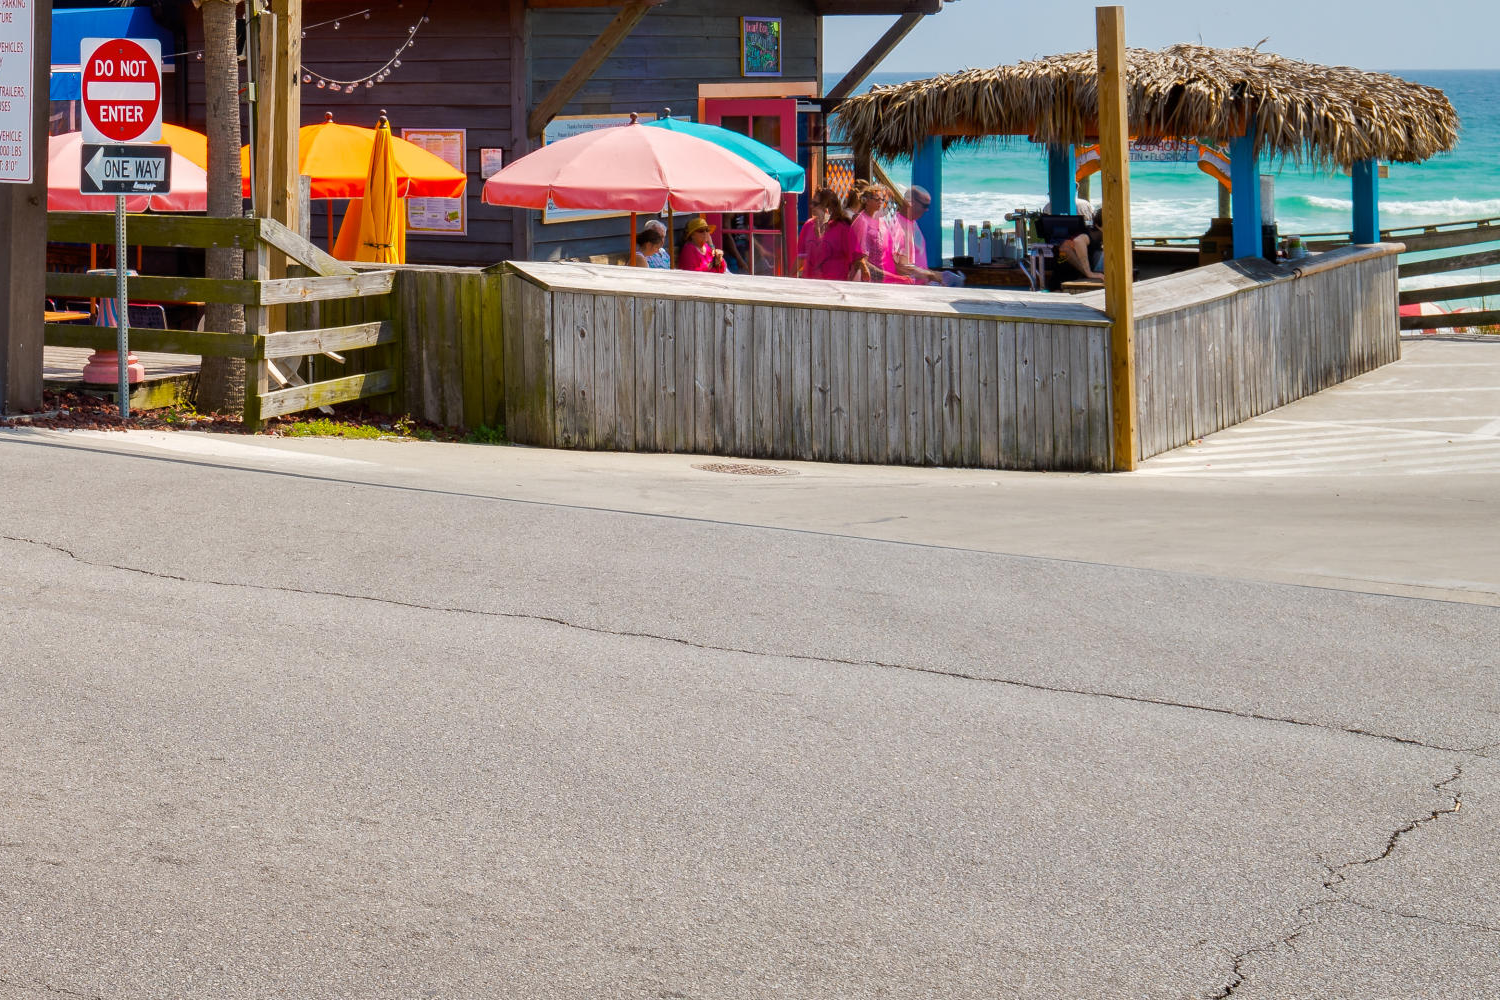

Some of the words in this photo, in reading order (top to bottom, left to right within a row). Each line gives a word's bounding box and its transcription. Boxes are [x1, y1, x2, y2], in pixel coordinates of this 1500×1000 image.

[94, 60, 114, 77] DO
[120, 60, 147, 77] NOT
[0, 86, 26, 99] TRAILERS,
[100, 105, 144, 122] ENTER
[12, 146, 22, 156] LBS
[1128, 141, 1156, 151] FOOD
[1150, 152, 1187, 161] FLORIDA
[104, 160, 130, 178] ONE
[135, 160, 161, 178] WAY
